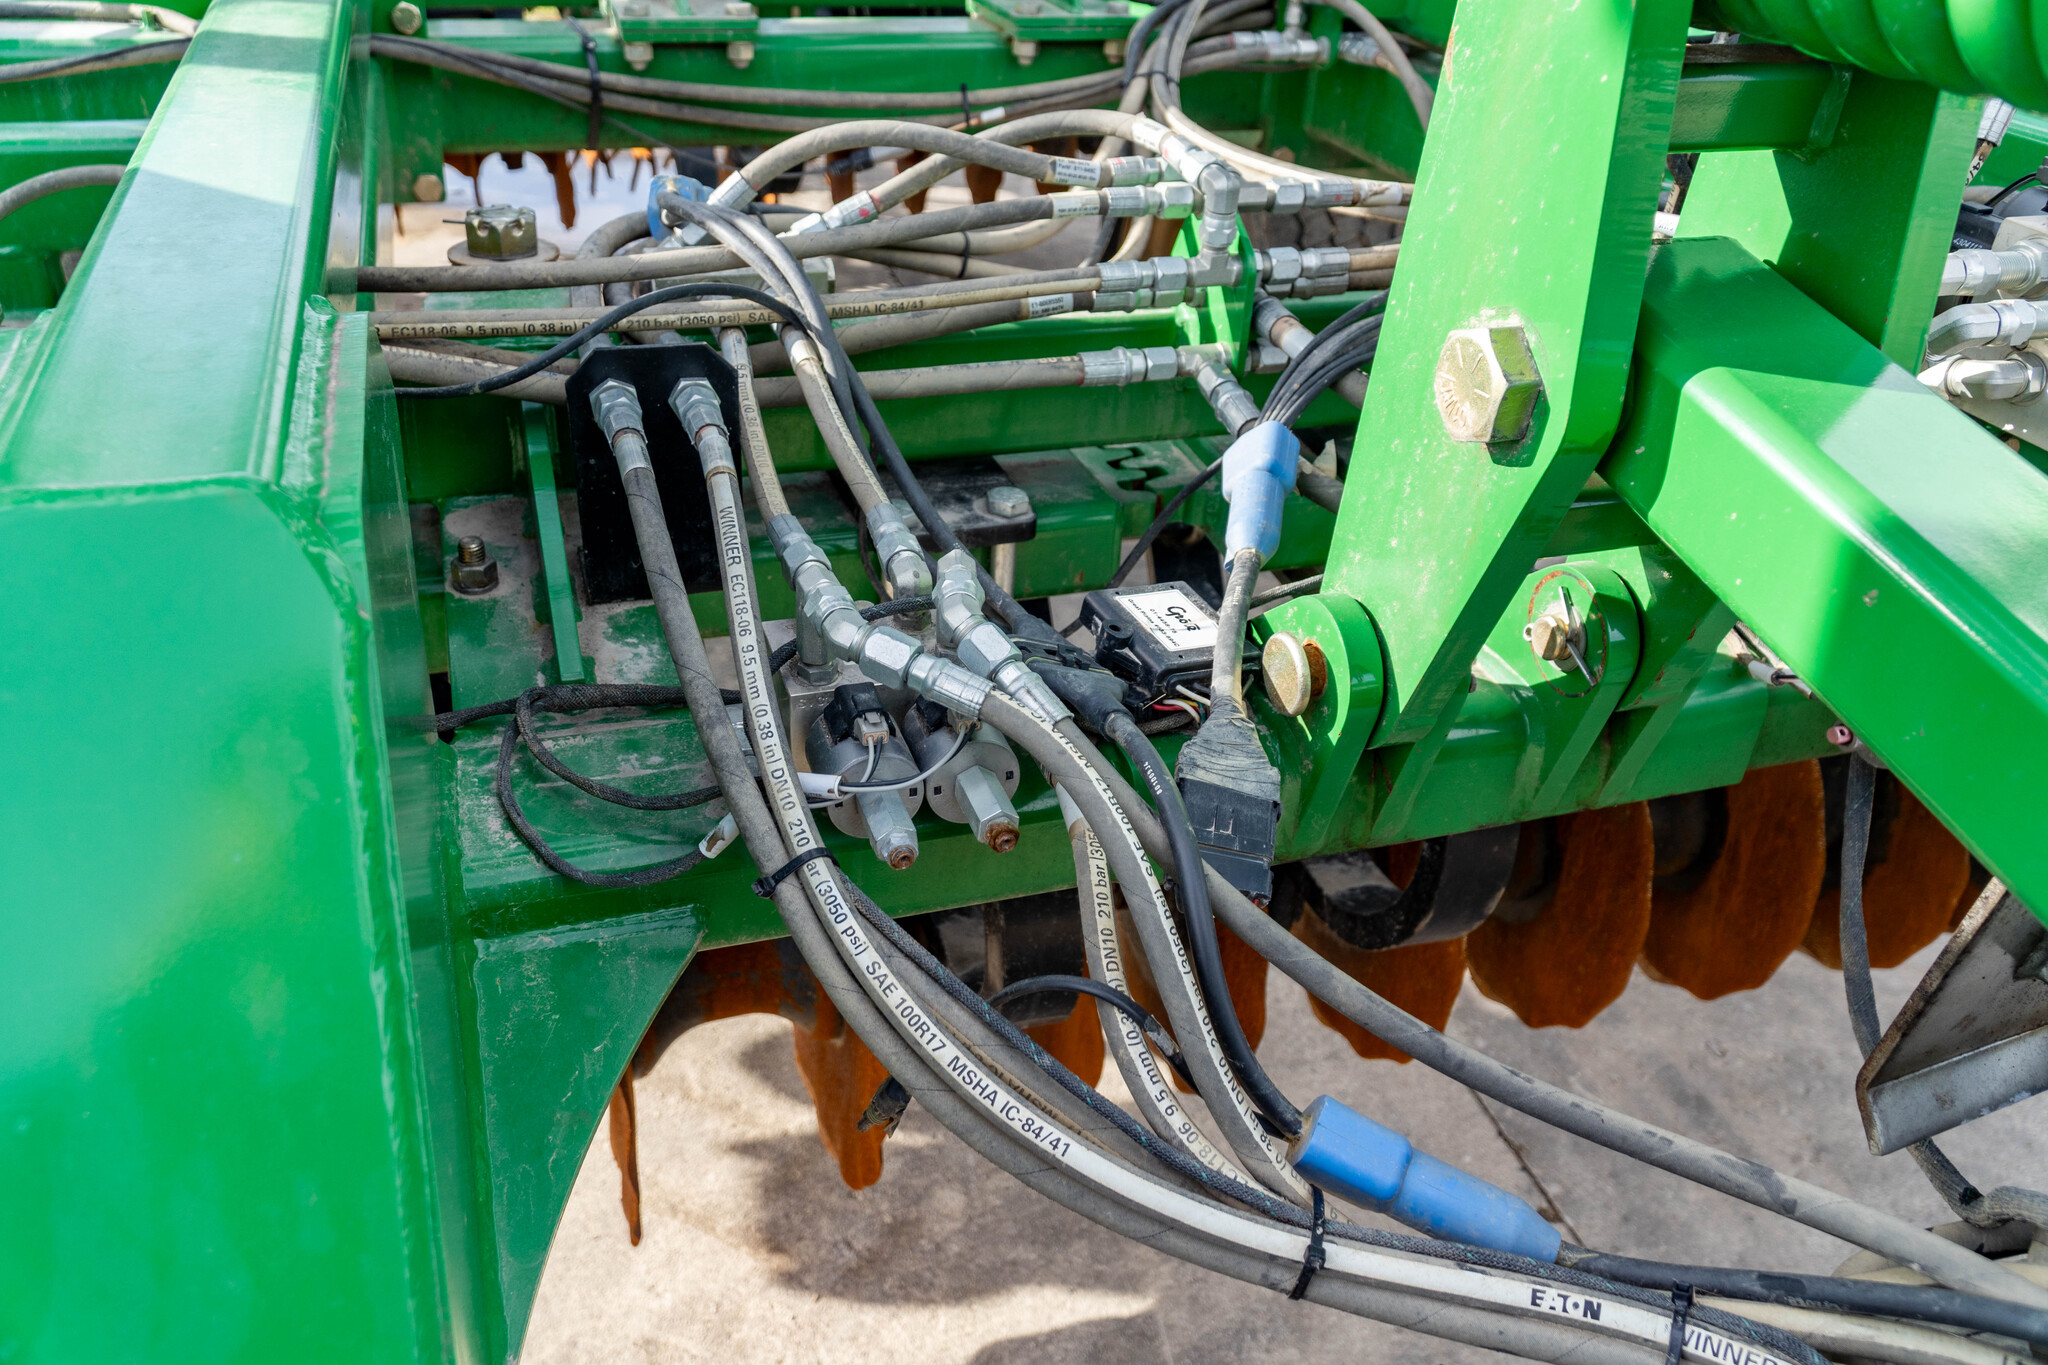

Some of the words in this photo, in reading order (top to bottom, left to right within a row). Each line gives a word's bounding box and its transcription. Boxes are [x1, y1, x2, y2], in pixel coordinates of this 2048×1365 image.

[391, 325, 457, 337] EC118-06
[466, 324, 486, 336] 9.5
[491, 325, 518, 336] mm
[522, 322, 556, 335] (0.38
[559, 321, 577, 333] in)
[627, 319, 650, 330] 210
[654, 318, 676, 328] bar
[679, 315, 714, 327] (3050
[718, 313, 741, 325] psi)
[748, 312, 775, 322] SAE
[831, 303, 871, 317] MSHA
[875, 300, 924, 314] IC-84/41
[719, 505, 742, 568] WINNER
[730, 573, 752, 637] EC118-06
[741, 643, 755, 667] 9.5
[745, 668, 760, 701] mm
[752, 702, 774, 749] (0.38
[763, 743, 781, 764] in)
[770, 766, 795, 812] DN10
[788, 817, 811, 848] 210
[806, 861, 821, 877] ar
[1093, 863, 1108, 889] bar
[815, 880, 848, 924] (3050
[1097, 891, 1112, 919] 210
[841, 924, 870, 957] psi)
[1099, 926, 1119, 973] DN10
[864, 960, 900, 999] SAE
[894, 996, 948, 1054] 100R17
[947, 1055, 1002, 1107] MSHA
[1138, 1051, 1162, 1085] mm
[1155, 1089, 1180, 1116] 9.5
[999, 1102, 1072, 1158] IC-84/41
